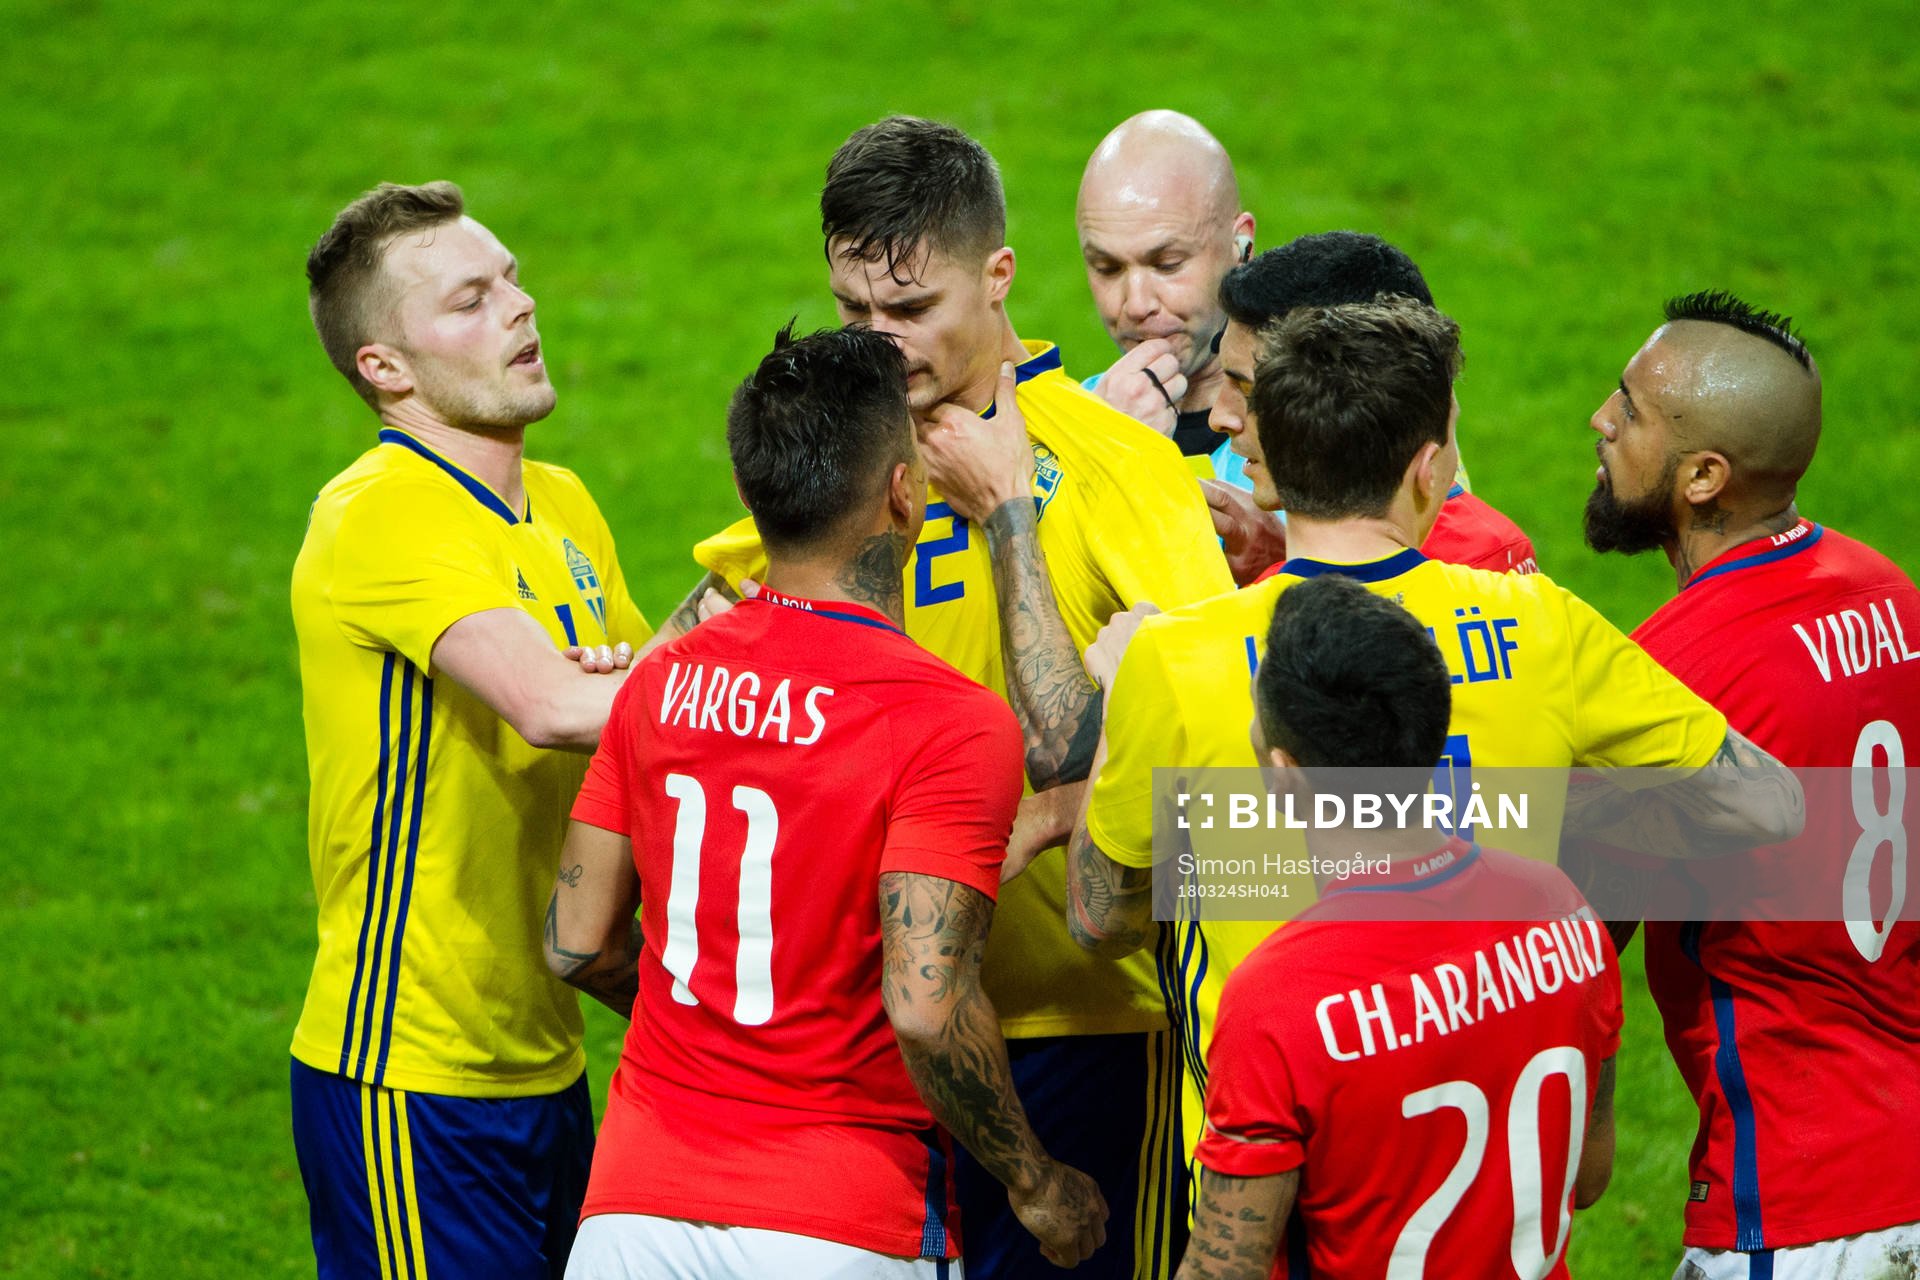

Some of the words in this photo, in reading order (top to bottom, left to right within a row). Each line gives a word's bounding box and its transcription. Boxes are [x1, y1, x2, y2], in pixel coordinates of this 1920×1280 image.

[915, 502, 969, 608] 2
[1771, 533, 1789, 546] LA
[1792, 598, 1920, 682] VIDAL
[660, 662, 835, 745] VARGAS
[1413, 861, 1430, 876] LA
[1842, 719, 1908, 963] 8
[662, 773, 779, 1026] 11
[1315, 905, 1606, 1062] CH.ARANGUIZ
[1385, 1046, 1588, 1280] 20
